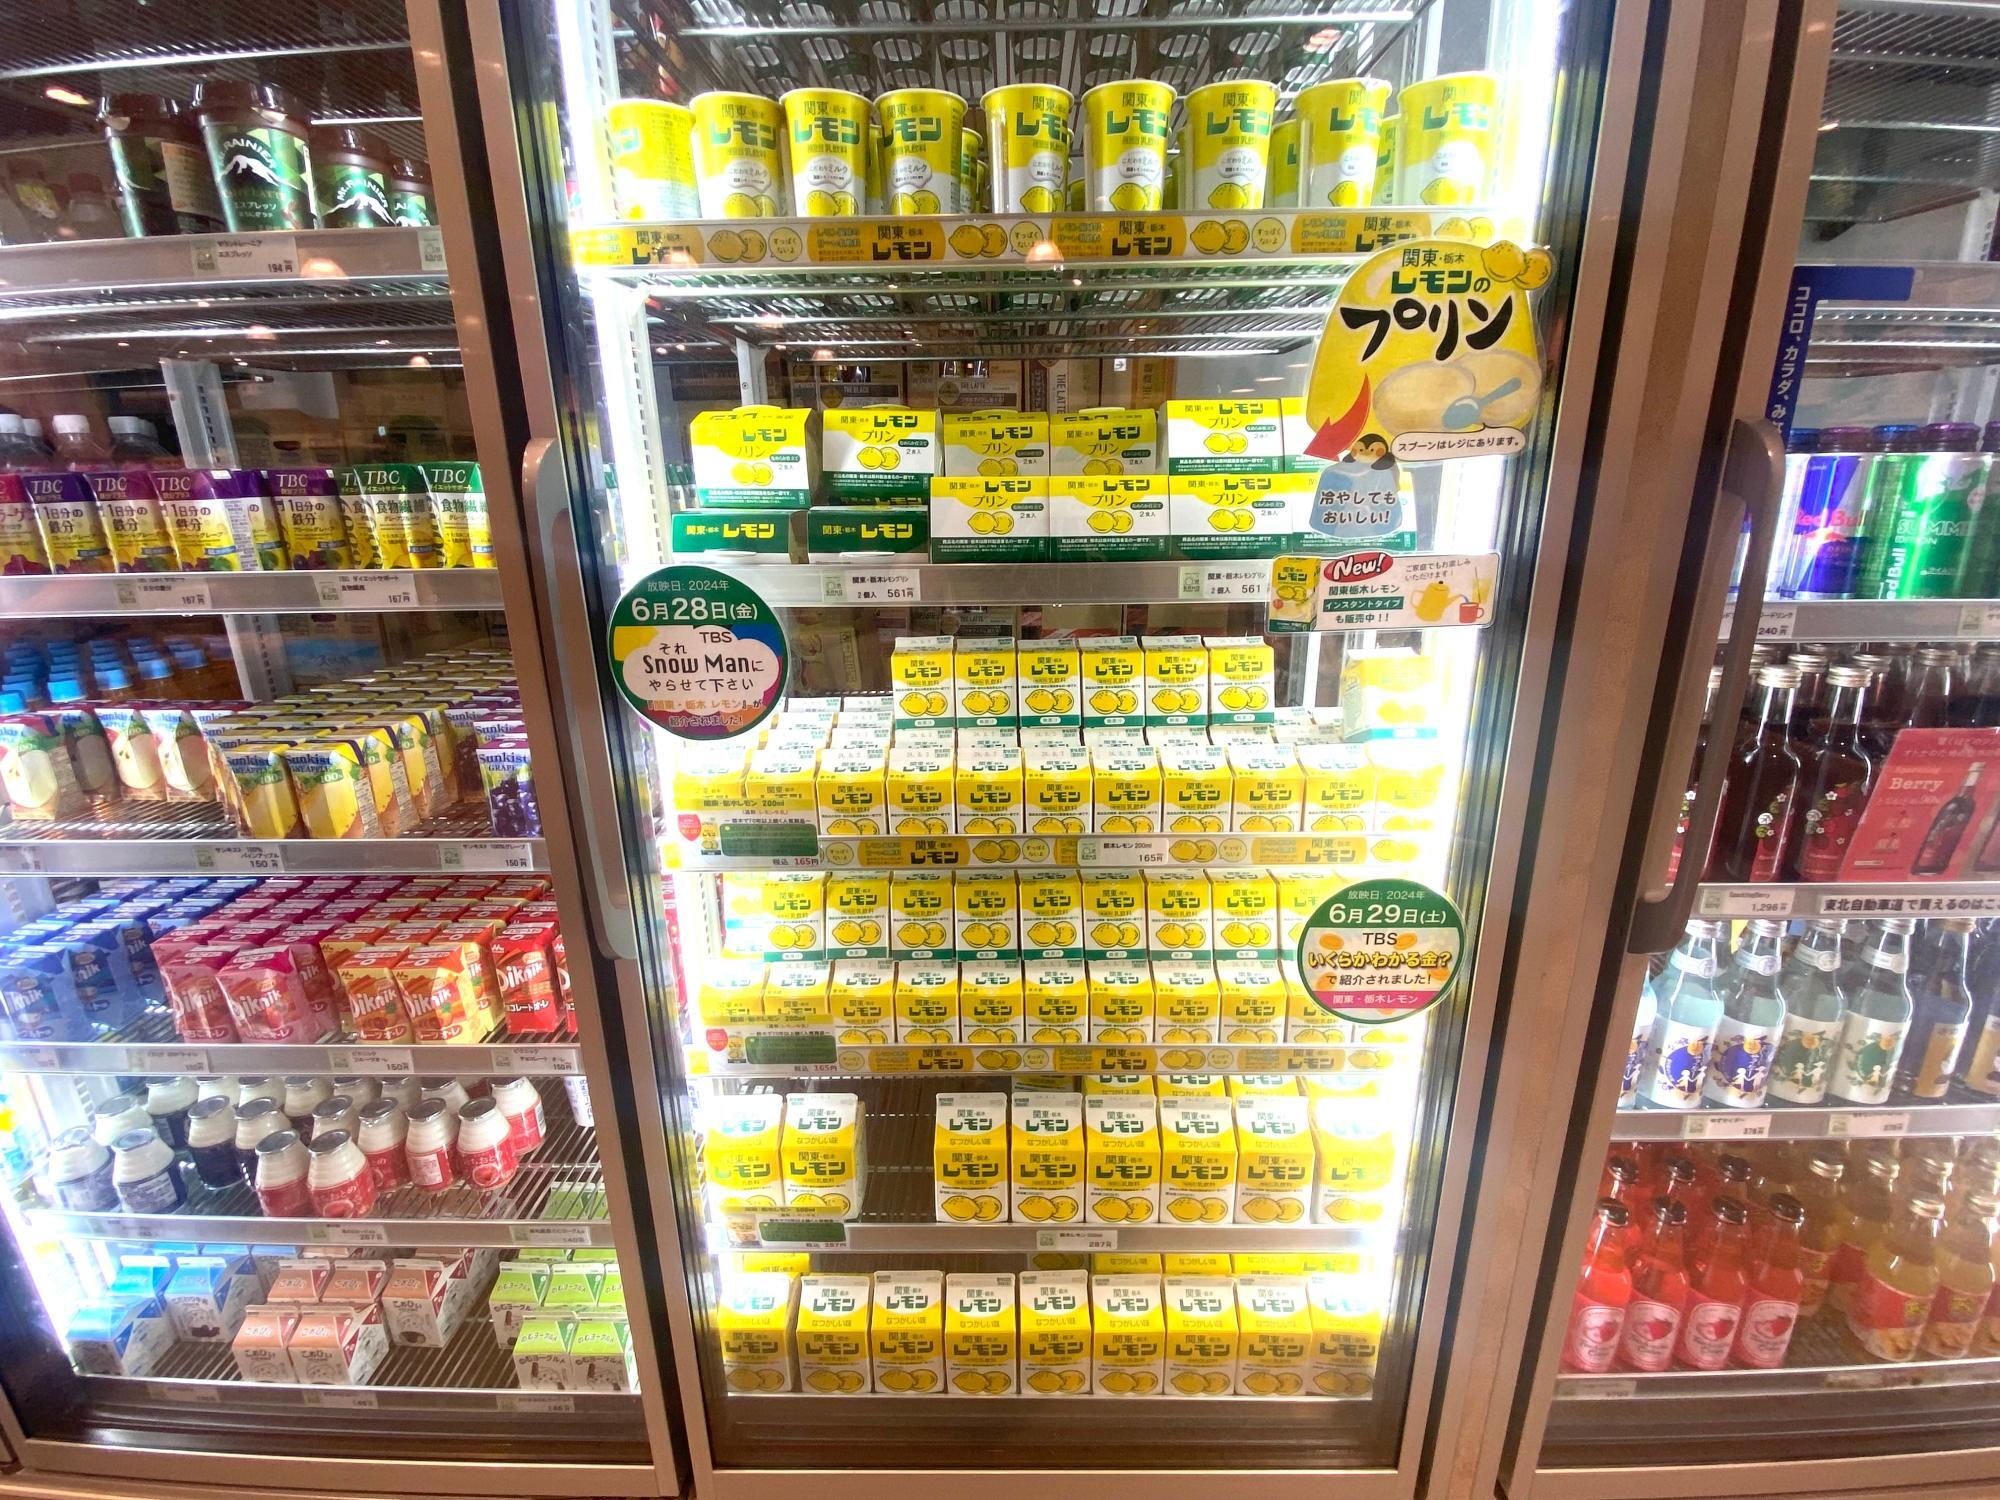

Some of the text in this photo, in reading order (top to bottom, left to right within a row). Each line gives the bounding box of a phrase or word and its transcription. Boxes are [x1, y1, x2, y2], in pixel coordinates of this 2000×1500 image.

[1207, 109, 1271, 135] レモン
[711, 120, 776, 150] レモン
[794, 117, 860, 144] レモン
[1119, 221, 1166, 235] 関東・栃木
[872, 242, 931, 260] レモン
[1112, 237, 1172, 255] レモン
[1401, 248, 1466, 268] 関東・栃木
[267, 259, 292, 274] 194円
[1391, 270, 1491, 294] レモンの
[1340, 295, 1513, 362] プリン
[1219, 402, 1264, 415] レモン
[874, 415, 918, 428] レモン
[1208, 417, 1242, 428] プリン
[742, 429, 787, 442] レモン
[862, 431, 895, 442] プリン
[991, 426, 1033, 440] レモン
[1098, 426, 1141, 440] レモン
[982, 443, 1014, 454] プリン
[1088, 444, 1120, 455] プリン
[1399, 435, 1520, 452] スプーンはレジにあります。
[276, 474, 308, 487] TBC
[365, 471, 400, 484] TBC
[431, 469, 466, 483] TBC
[31, 480, 63, 493] TBC
[97, 477, 127, 492] TBC
[158, 477, 191, 491] TBC
[984, 480, 1031, 492] レモン
[1103, 479, 1150, 492] レモン
[1224, 478, 1271, 491] レモン
[973, 496, 1009, 507] プリン
[1092, 495, 1128, 507] プリン
[1212, 493, 1248, 504] プリン
[1320, 491, 1396, 506] 冷やしても
[108, 505, 148, 517] 1日分の
[171, 504, 211, 518] 1日分の
[289, 500, 325, 512] 1日分の
[44, 507, 83, 519] 1日分の
[1139, 510, 1156, 518] 2食入
[1323, 511, 1390, 524] おいしい!
[49, 521, 74, 533] 鉄分
[113, 519, 138, 531] 鉄分
[176, 518, 201, 531] 鉄分
[723, 524, 775, 539] レモン
[861, 524, 912, 539] レモン
[1333, 553, 1386, 580] New!
[852, 576, 909, 584] 関東・栃木レモンプリン
[1278, 572, 1307, 581] レモン
[887, 588, 914, 599] 561円
[1211, 586, 1231, 595] 2個入
[1329, 585, 1401, 595] 関東栃木レモン
[631, 597, 757, 621] 6月28日(金)
[1325, 599, 1401, 610] インスタントタイプ
[699, 632, 732, 644] TBS
[659, 643, 687, 655] それ
[643, 654, 699, 674] Snow
[1096, 664, 1133, 676] レモン
[905, 667, 942, 678] レモン
[649, 678, 754, 692] やらせて下さい
[479, 753, 528, 765] Sunkist
[488, 764, 516, 772] GRAPE
[1888, 778, 1944, 792] Berry
[901, 792, 941, 803] レモン
[1108, 790, 1150, 801] レモン
[1321, 789, 1363, 801] レモン
[911, 851, 958, 864] レモン
[1138, 852, 1162, 862] 165円
[1304, 848, 1356, 862] レモン
[794, 858, 818, 866] 165円
[839, 894, 877, 907] レモン
[1387, 890, 1425, 900] 2024年
[1033, 895, 1071, 909] レモン
[1227, 895, 1265, 909] レモン
[1329, 903, 1446, 924] 6月29日(土)
[1363, 932, 1398, 945] TBS
[1308, 952, 1452, 969] いくらかわかる金?
[1327, 974, 1431, 985] で紹介されました!
[1333, 995, 1418, 1004] 関東・栃木レモン
[843, 1006, 881, 1018] レモン
[1038, 1005, 1077, 1016] レモン
[1235, 1005, 1275, 1016] レモン
[918, 1058, 964, 1070] レモン
[1101, 1058, 1147, 1070] レモン
[1287, 1057, 1335, 1069] レモン
[798, 1117, 841, 1130] レモン
[1100, 1120, 1144, 1133] レモン
[797, 1137, 839, 1145] なつかしい味
[1026, 1139, 1069, 1147] なつかしい味
[1178, 1140, 1221, 1149] なつかしい味
[790, 1162, 846, 1176] レモン
[1095, 1165, 1152, 1179] レモン
[813, 1298, 855, 1312] レモン
[1107, 1298, 1149, 1312] レモン
[886, 1317, 927, 1325] なつかしい味
[880, 1341, 933, 1353] レモン
[1103, 1344, 1157, 1356] レモン
[1319, 1342, 1376, 1355] レモン
